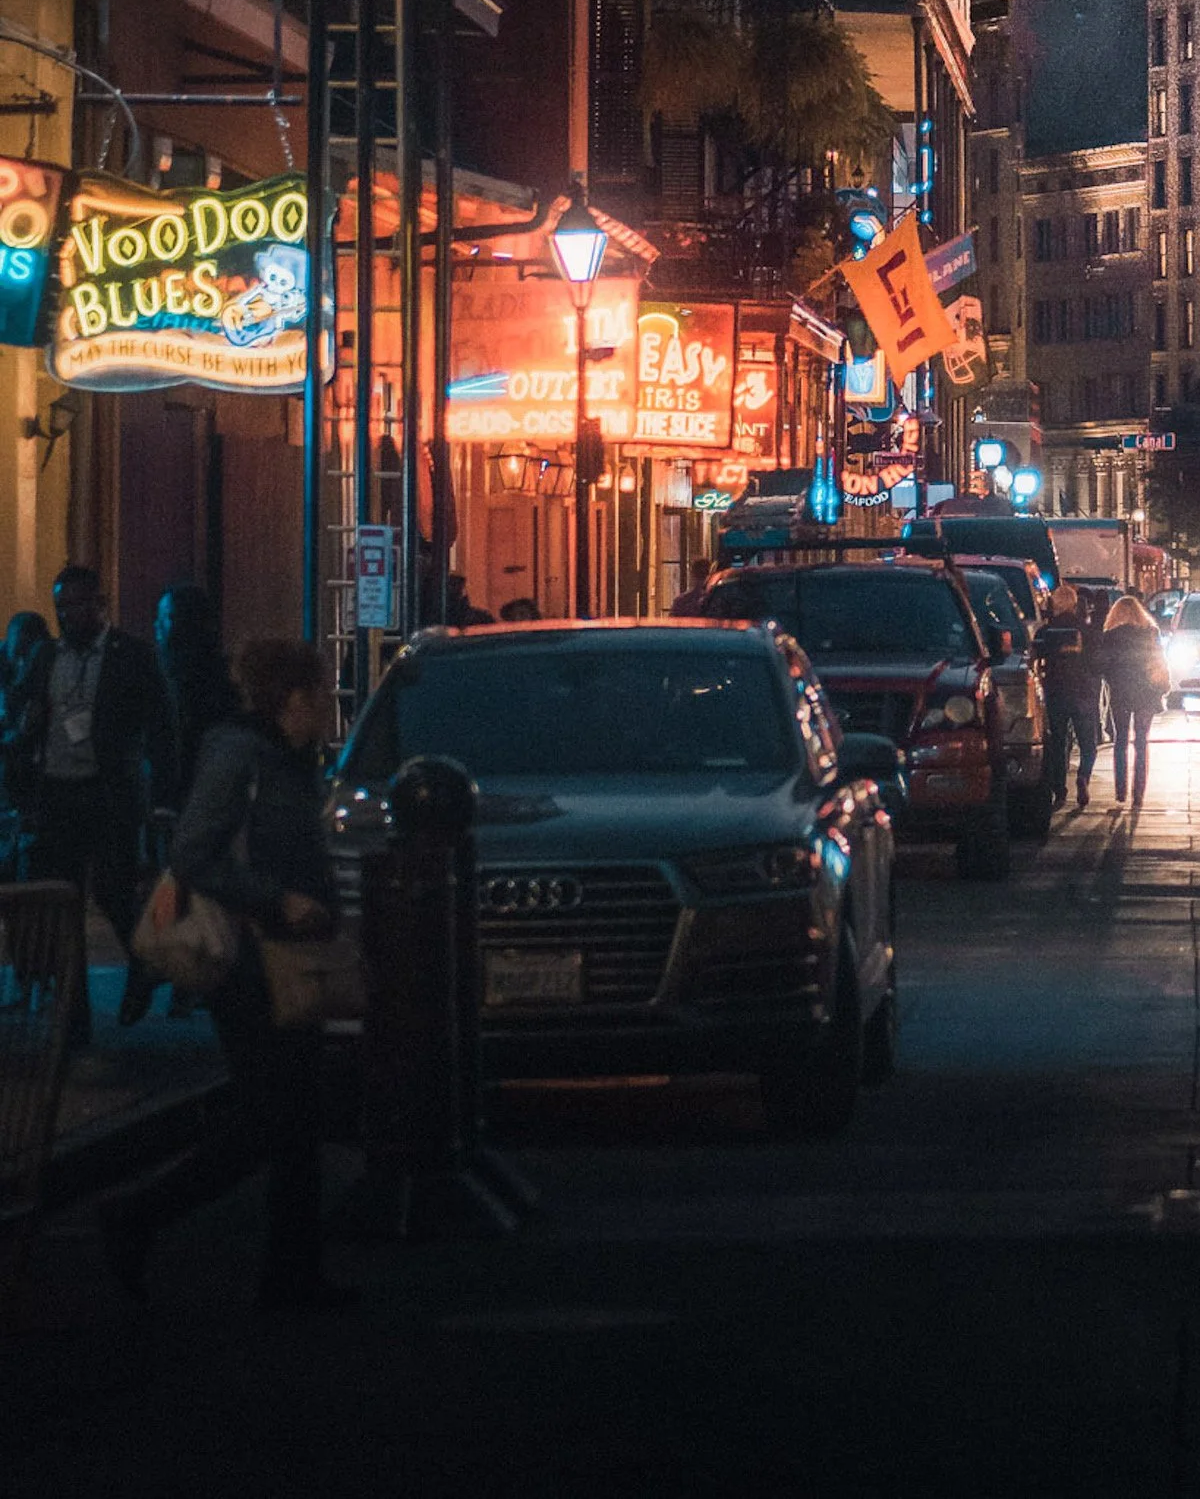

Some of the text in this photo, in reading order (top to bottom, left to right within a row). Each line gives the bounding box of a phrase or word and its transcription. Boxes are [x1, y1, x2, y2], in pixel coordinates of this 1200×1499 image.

[71, 191, 309, 276] VOODOO
[70, 259, 223, 338] BLUES
[69, 342, 102, 366] MAY
[109, 339, 137, 362] THE
[142, 341, 195, 367] CURSE
[202, 349, 224, 373] BE
[232, 353, 279, 376] WITH
[638, 332, 727, 386] EASY
[508, 369, 625, 402] OUTET
[1135, 434, 1167, 449] Canal
